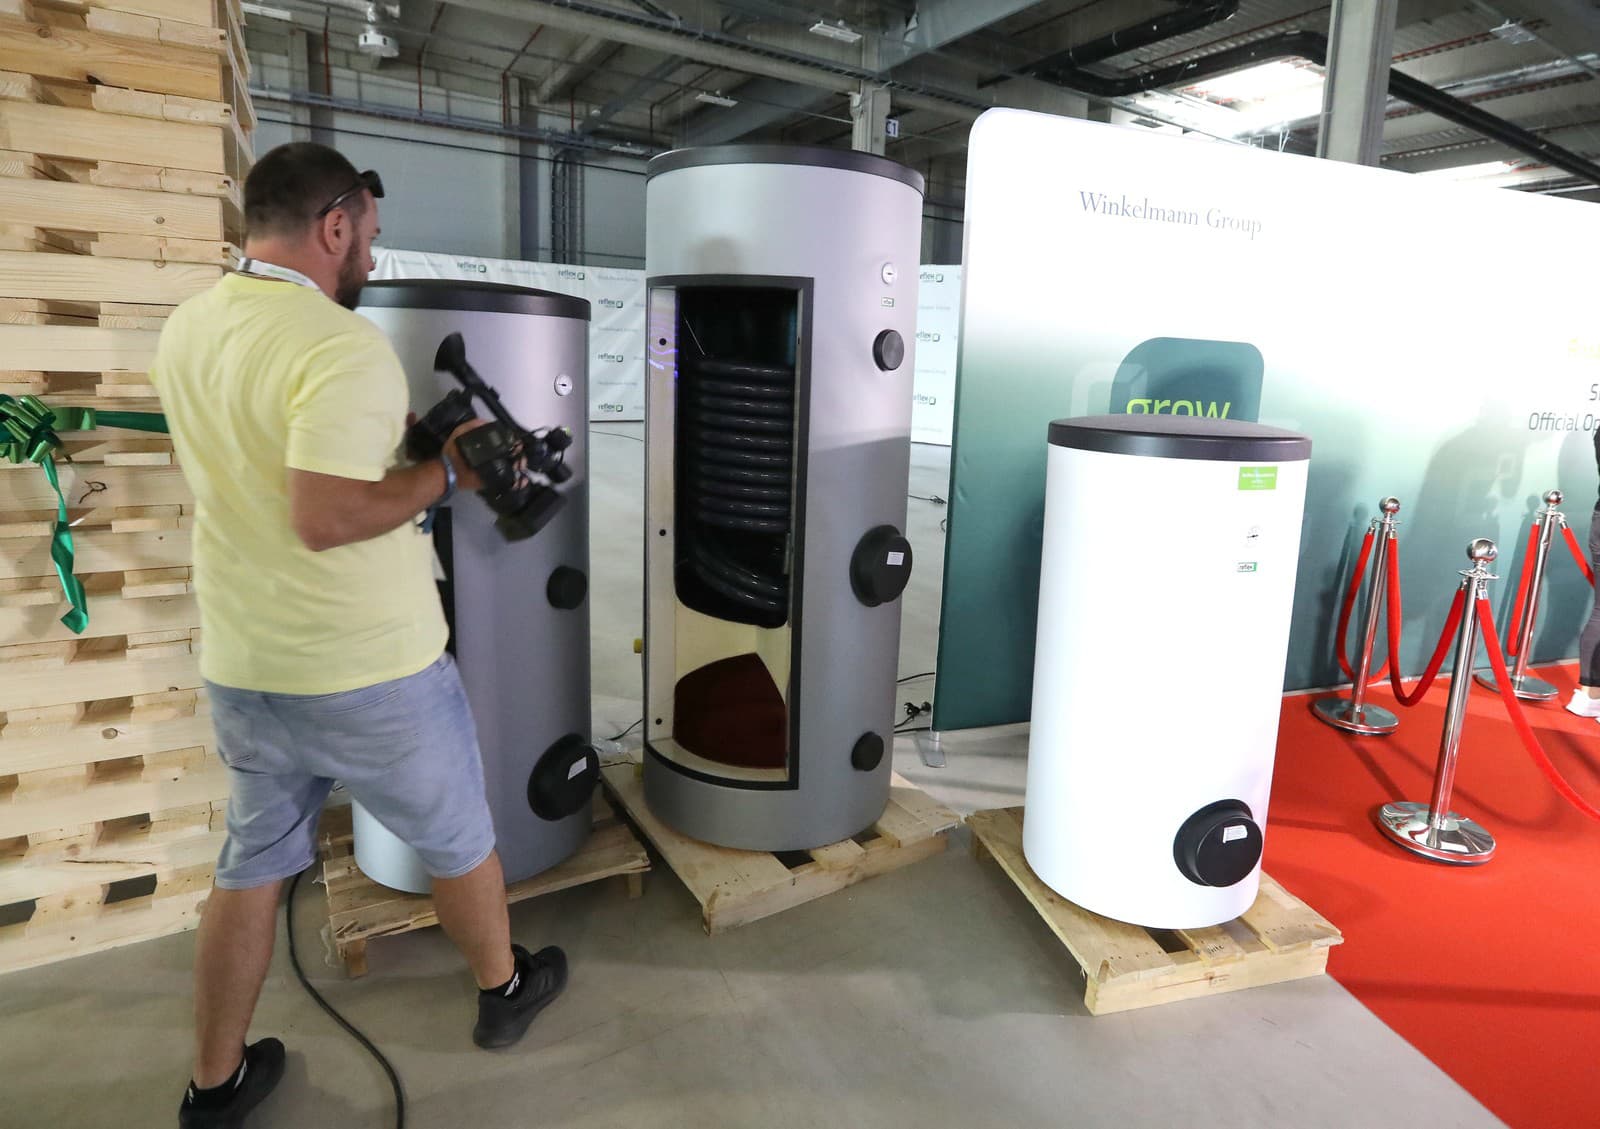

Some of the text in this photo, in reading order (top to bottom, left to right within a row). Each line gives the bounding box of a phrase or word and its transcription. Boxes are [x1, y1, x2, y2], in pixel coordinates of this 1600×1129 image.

[1080, 190, 1262, 241] Winkelmann Group
[558, 269, 576, 277] reflex
[1528, 411, 1578, 431] Official
